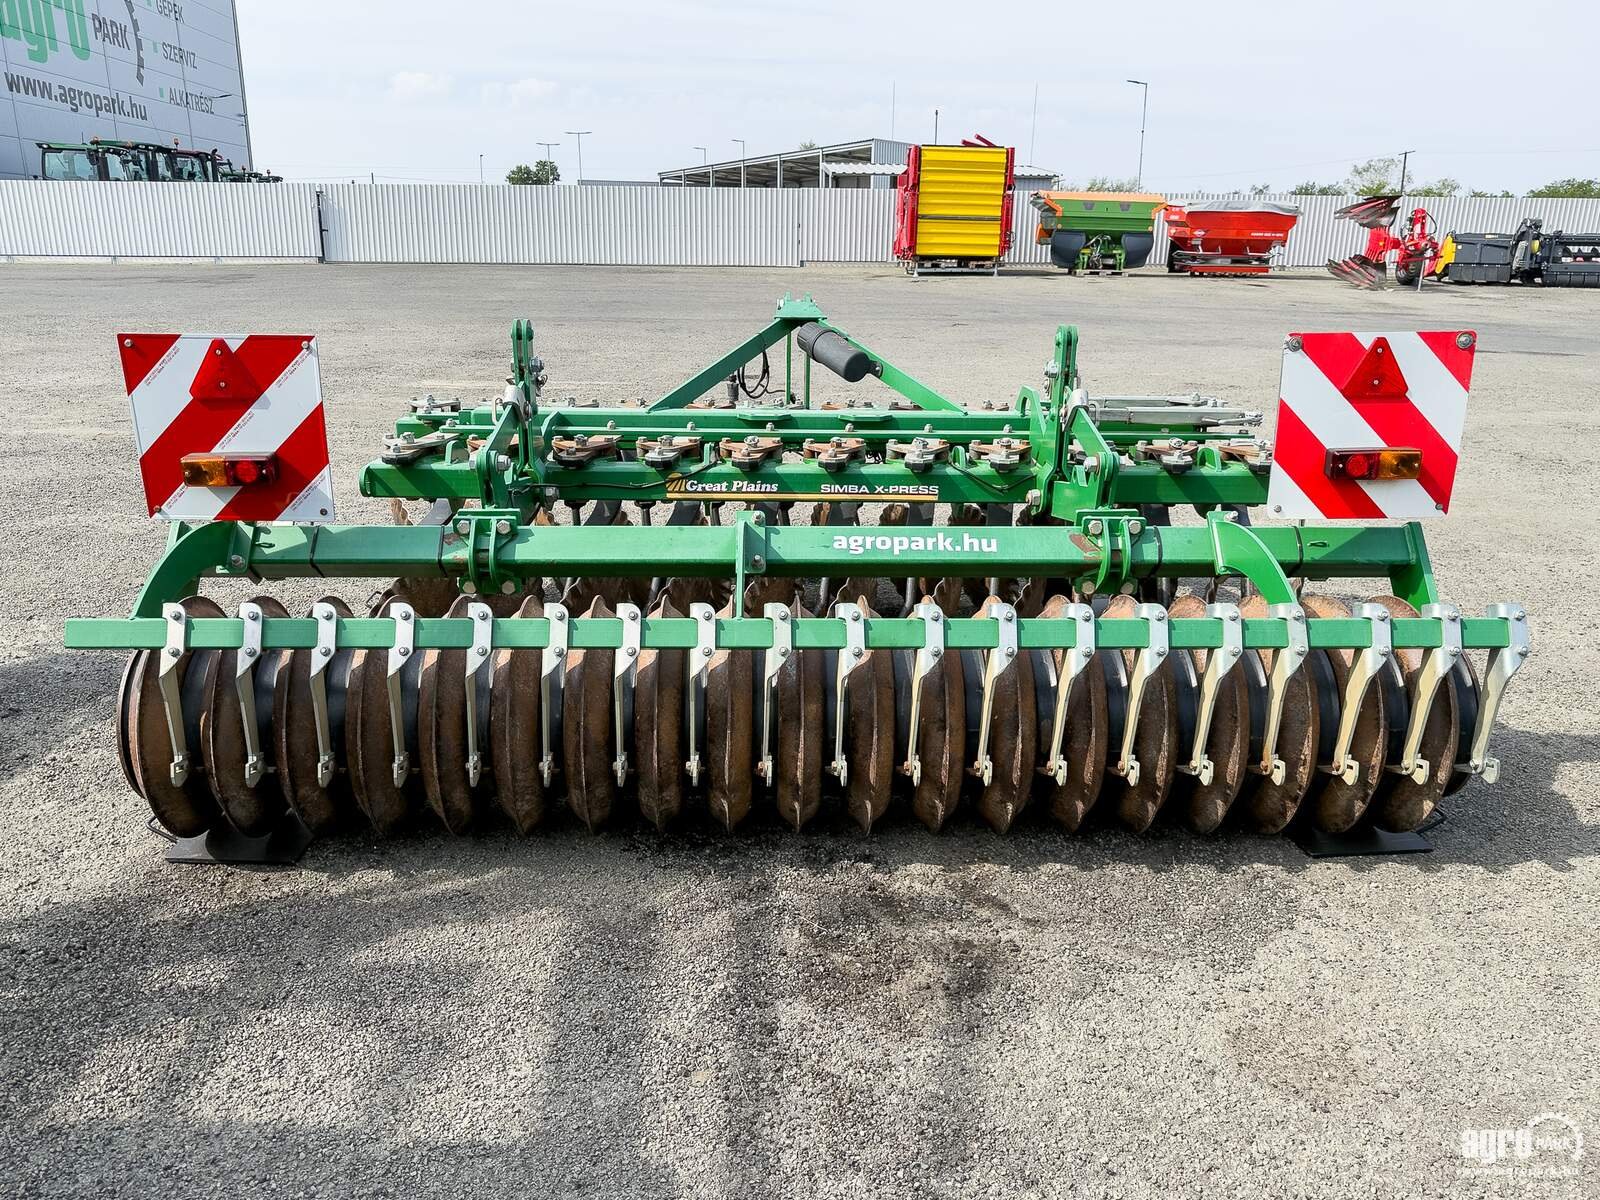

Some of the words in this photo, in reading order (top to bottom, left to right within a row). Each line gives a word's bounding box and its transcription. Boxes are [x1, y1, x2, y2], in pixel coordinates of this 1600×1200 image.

[91, 13, 130, 51] PARK
[162, 41, 197, 70] SZERVIZ
[4, 71, 148, 121] www.agropark.hu
[168, 87, 215, 115] ALKATRÉSZ
[687, 480, 728, 492] Great
[732, 480, 778, 493] Plains
[820, 484, 870, 494] SIMBA
[874, 485, 939, 495] X-PRESS
[833, 532, 998, 554] agropark.hu
